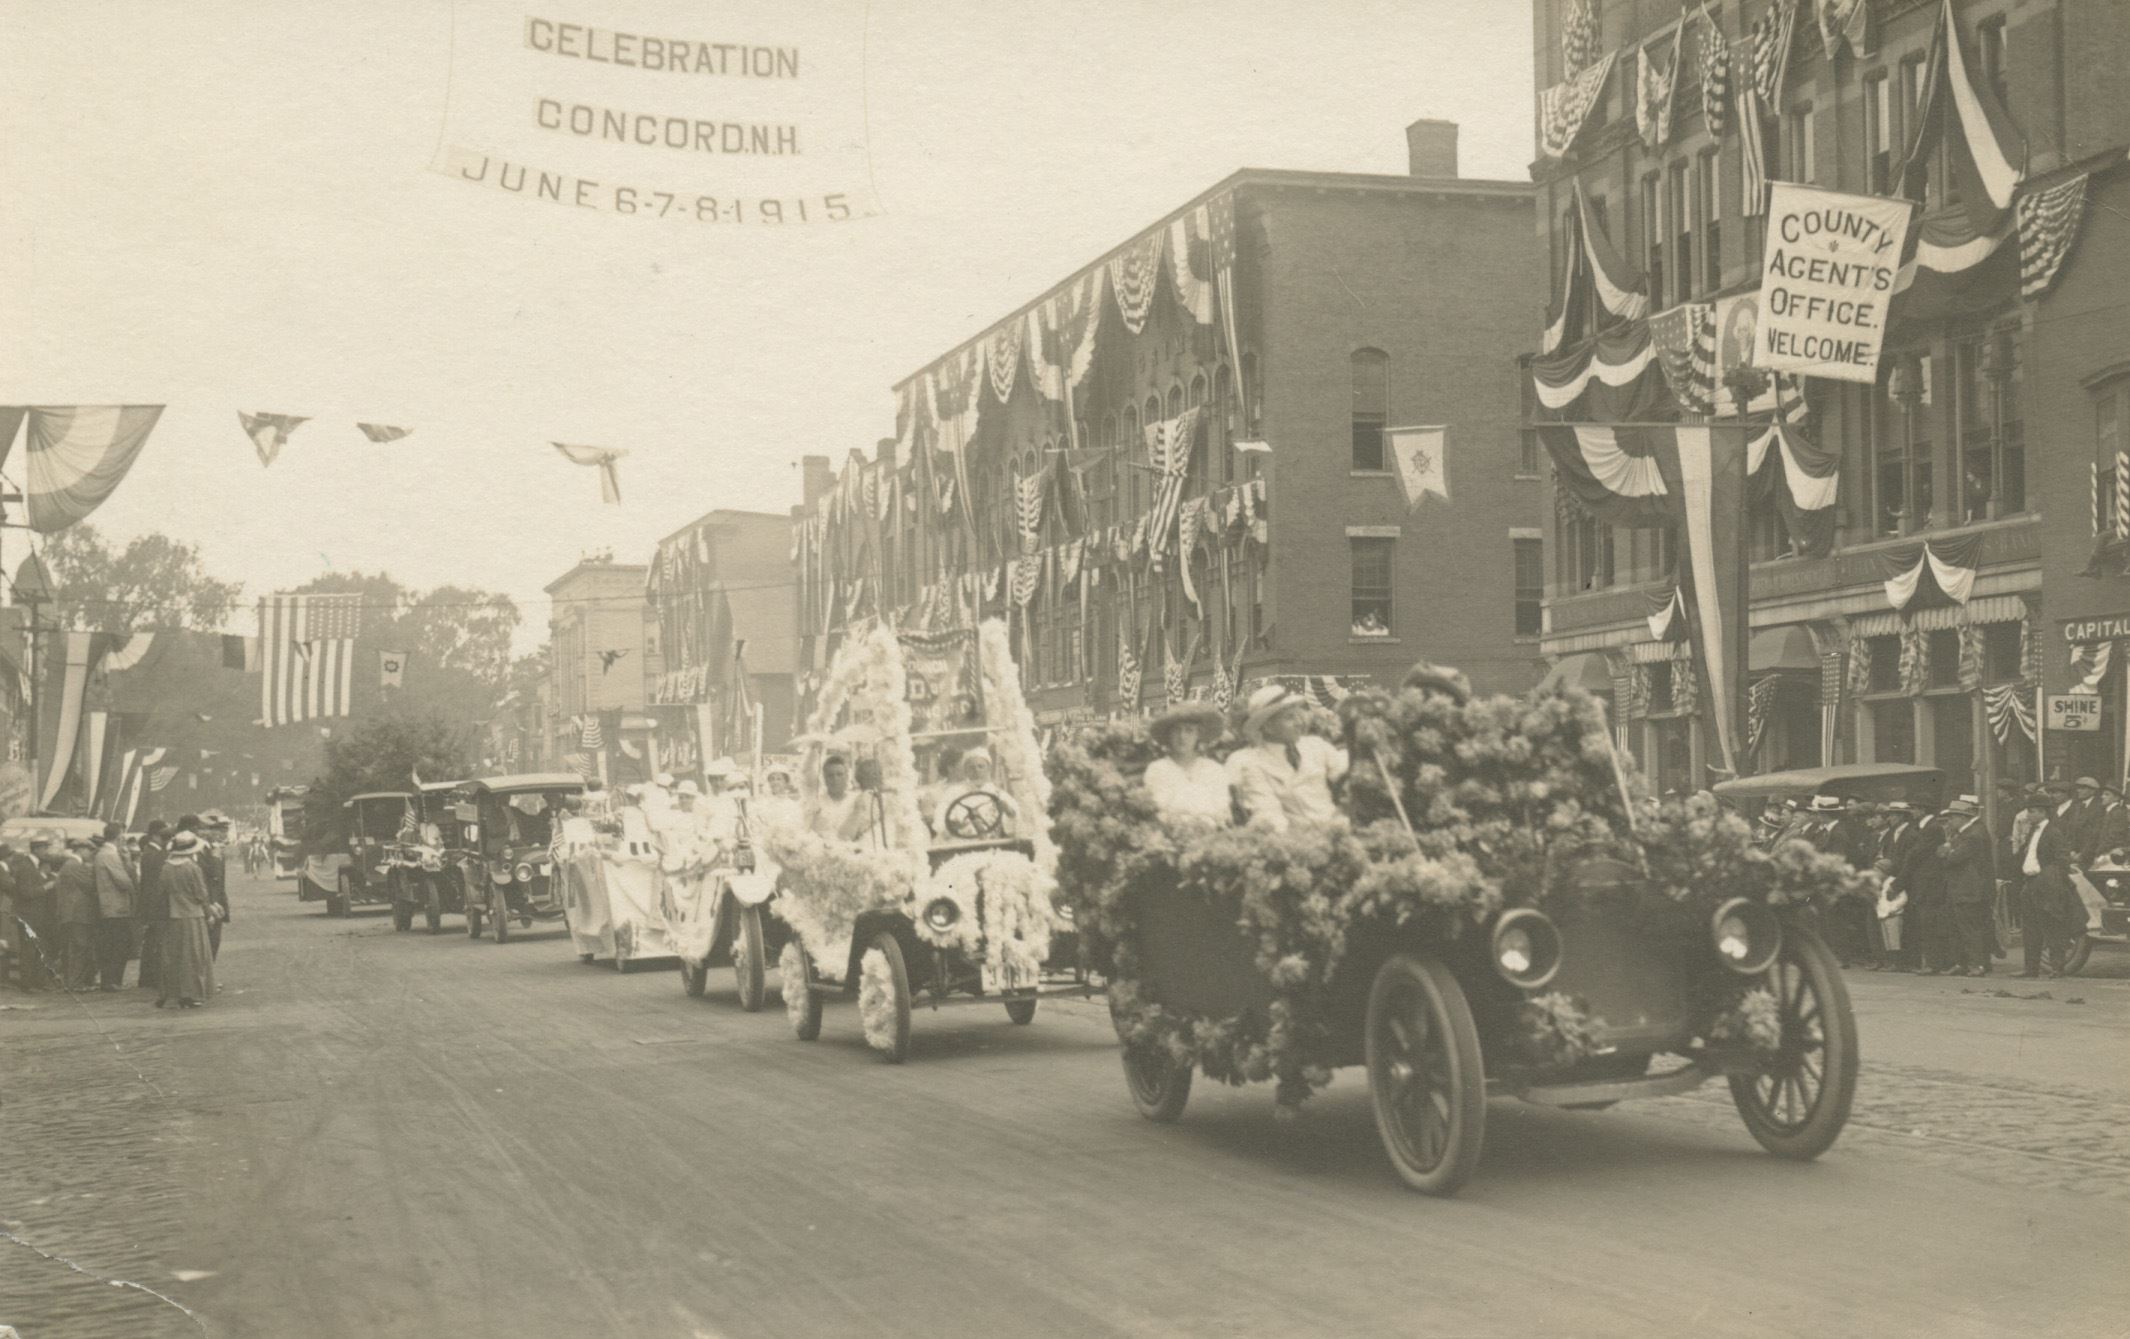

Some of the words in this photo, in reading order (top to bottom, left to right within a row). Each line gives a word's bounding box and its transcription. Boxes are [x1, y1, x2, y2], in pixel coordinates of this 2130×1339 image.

[530, 17, 799, 79] CELEBRATION
[461, 156, 599, 210] JUNE
[1780, 209, 1894, 255] COUNTY
[1769, 248, 1893, 291] AGENT'S
[2054, 700, 2098, 714] SHINE
